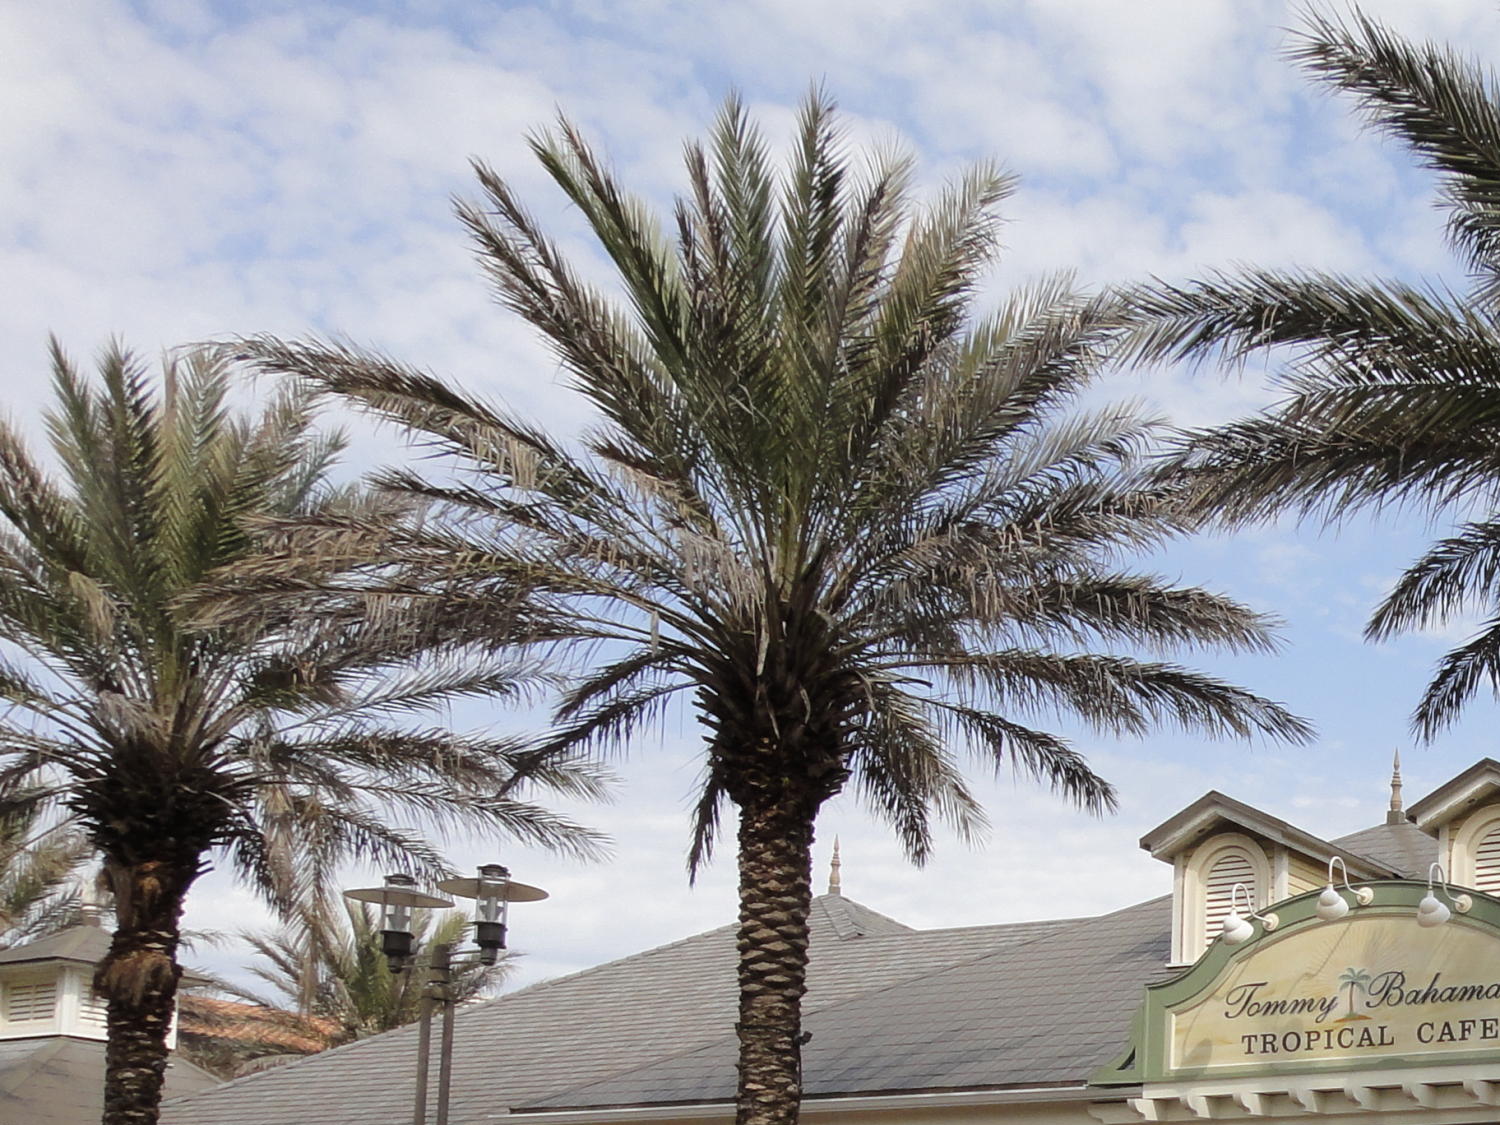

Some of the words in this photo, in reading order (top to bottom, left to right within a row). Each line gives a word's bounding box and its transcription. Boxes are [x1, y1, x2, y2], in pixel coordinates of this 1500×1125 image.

[1224, 981, 1338, 1023] Tommy
[1241, 1025, 1395, 1055] TROPICAL
[1416, 1017, 1500, 1042] CAFE
